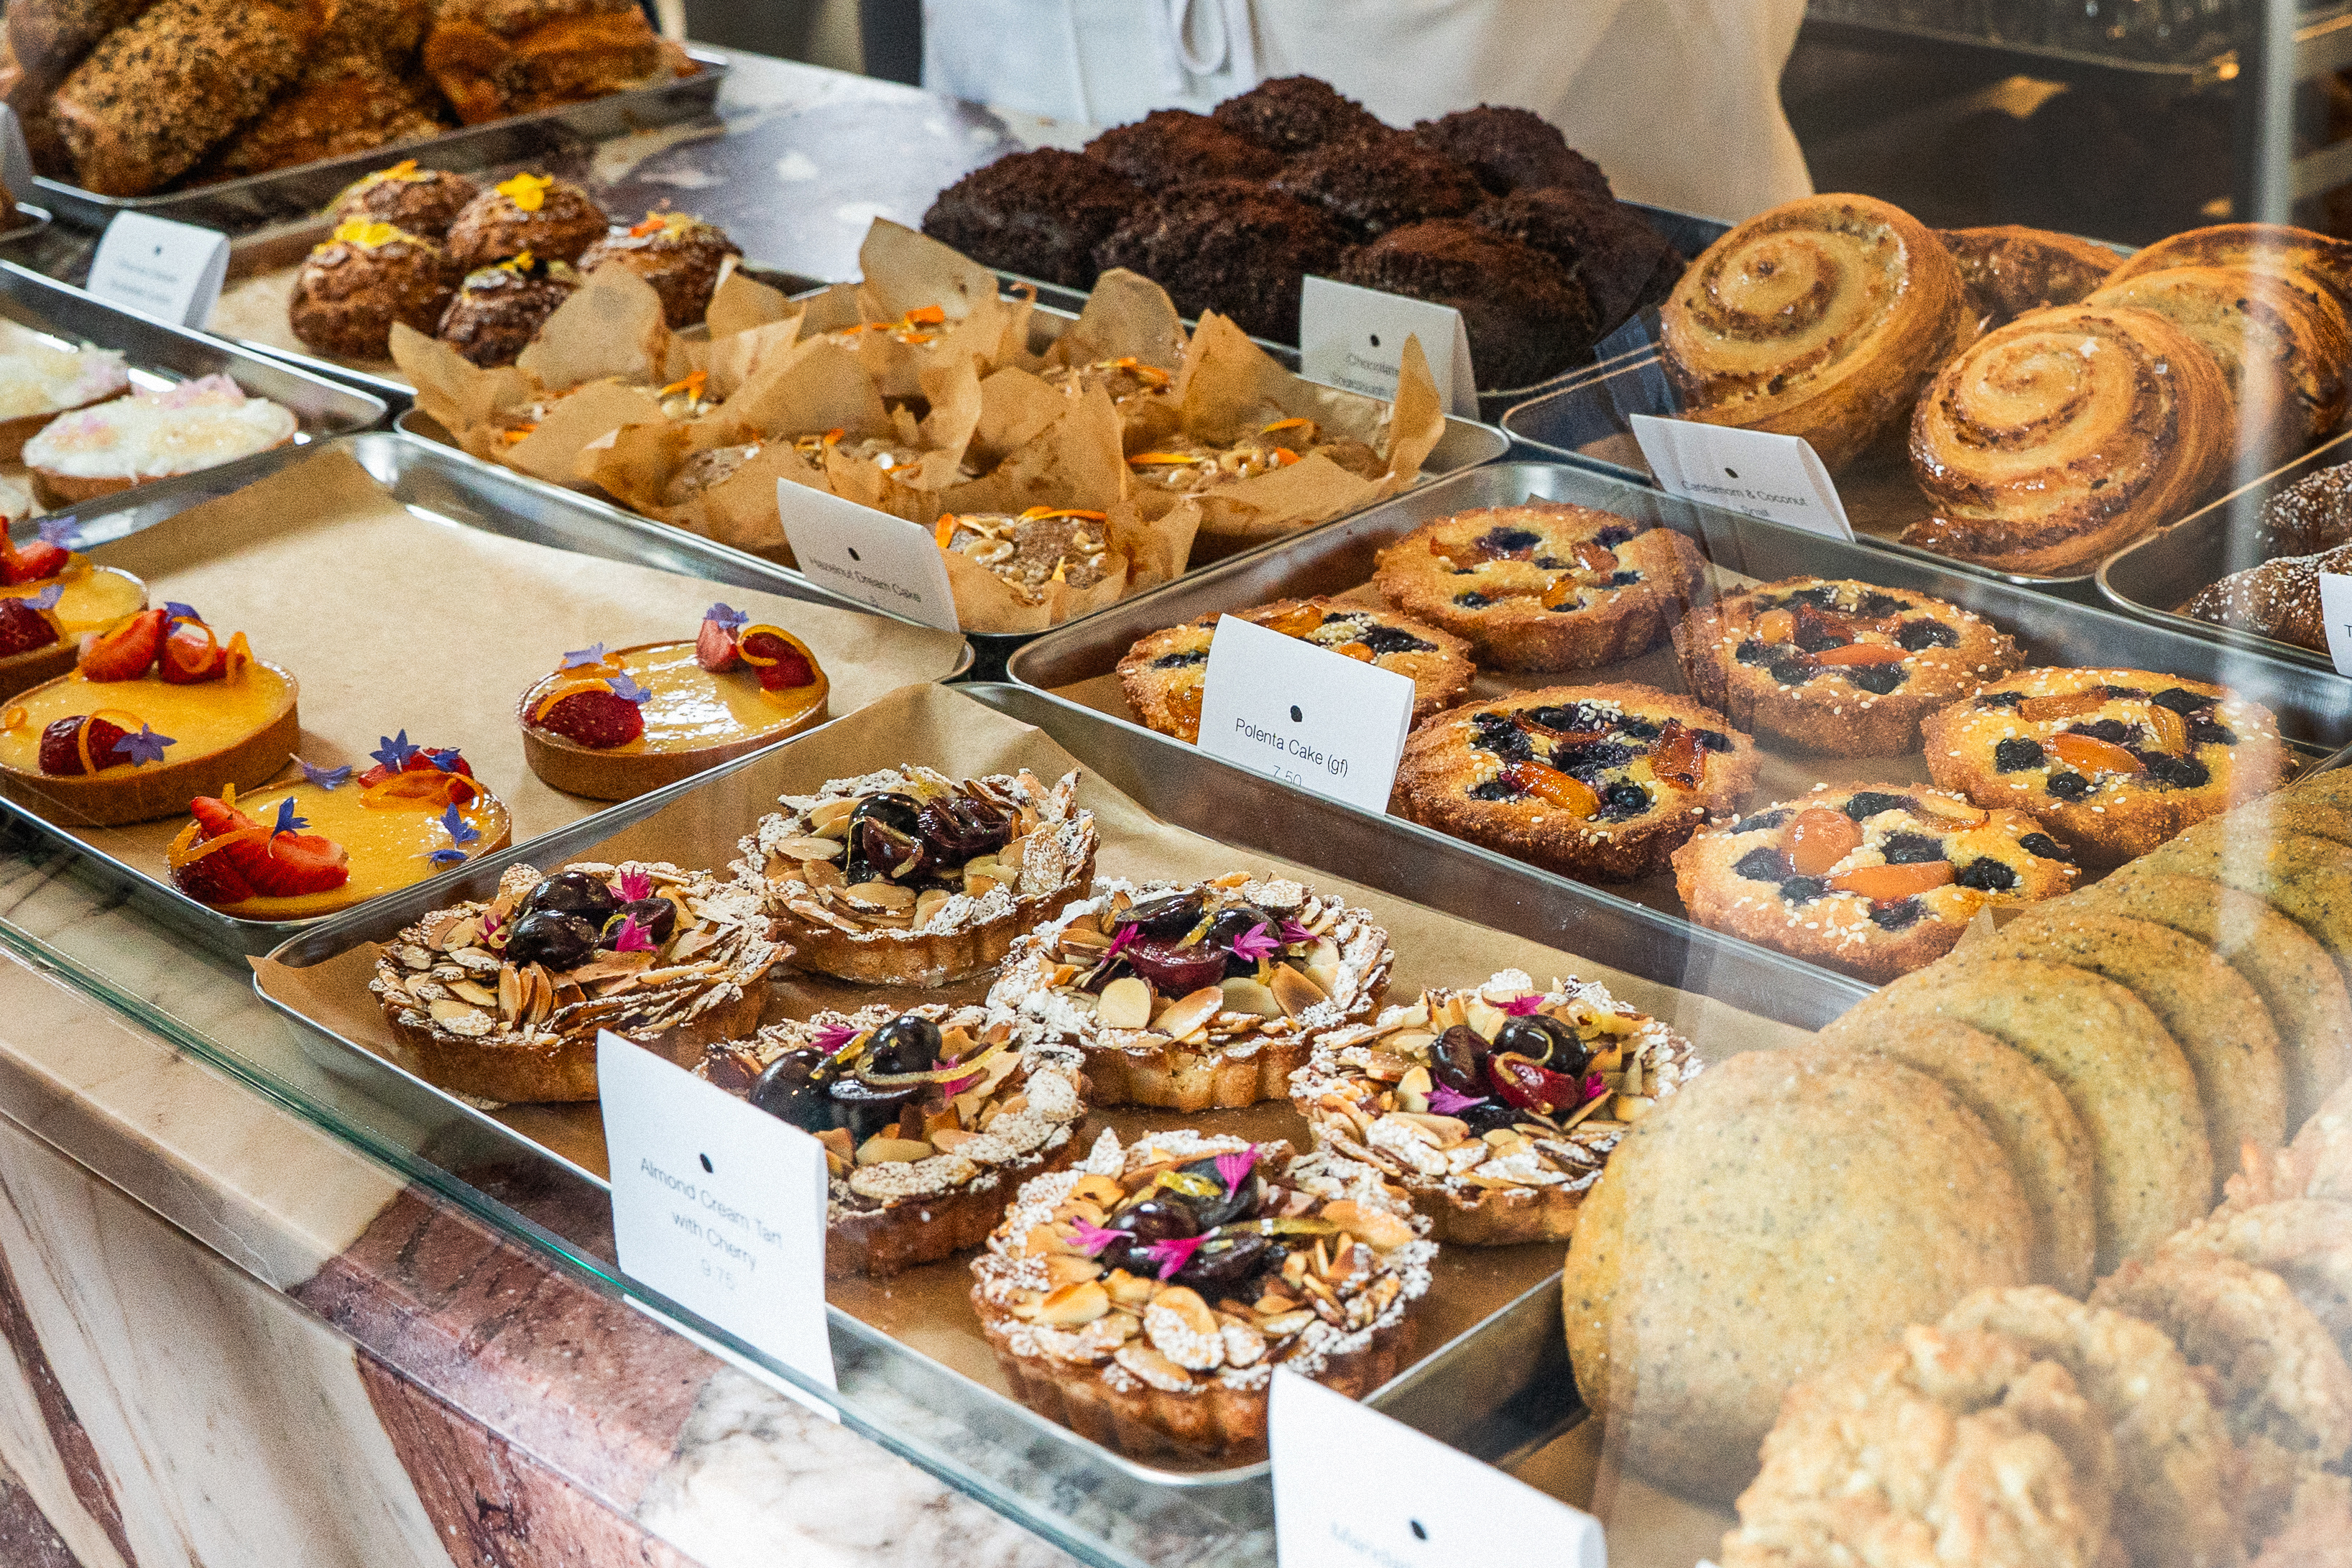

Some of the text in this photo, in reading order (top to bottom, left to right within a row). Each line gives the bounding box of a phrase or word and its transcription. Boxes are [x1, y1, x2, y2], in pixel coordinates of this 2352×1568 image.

[1235, 718, 1348, 778] Polenta Cake (gf)
[1273, 765, 1302, 786] 7.50
[640, 1157, 696, 1200] Almond
[700, 1189, 750, 1230] Cream
[672, 1212, 757, 1271] with Cherry
